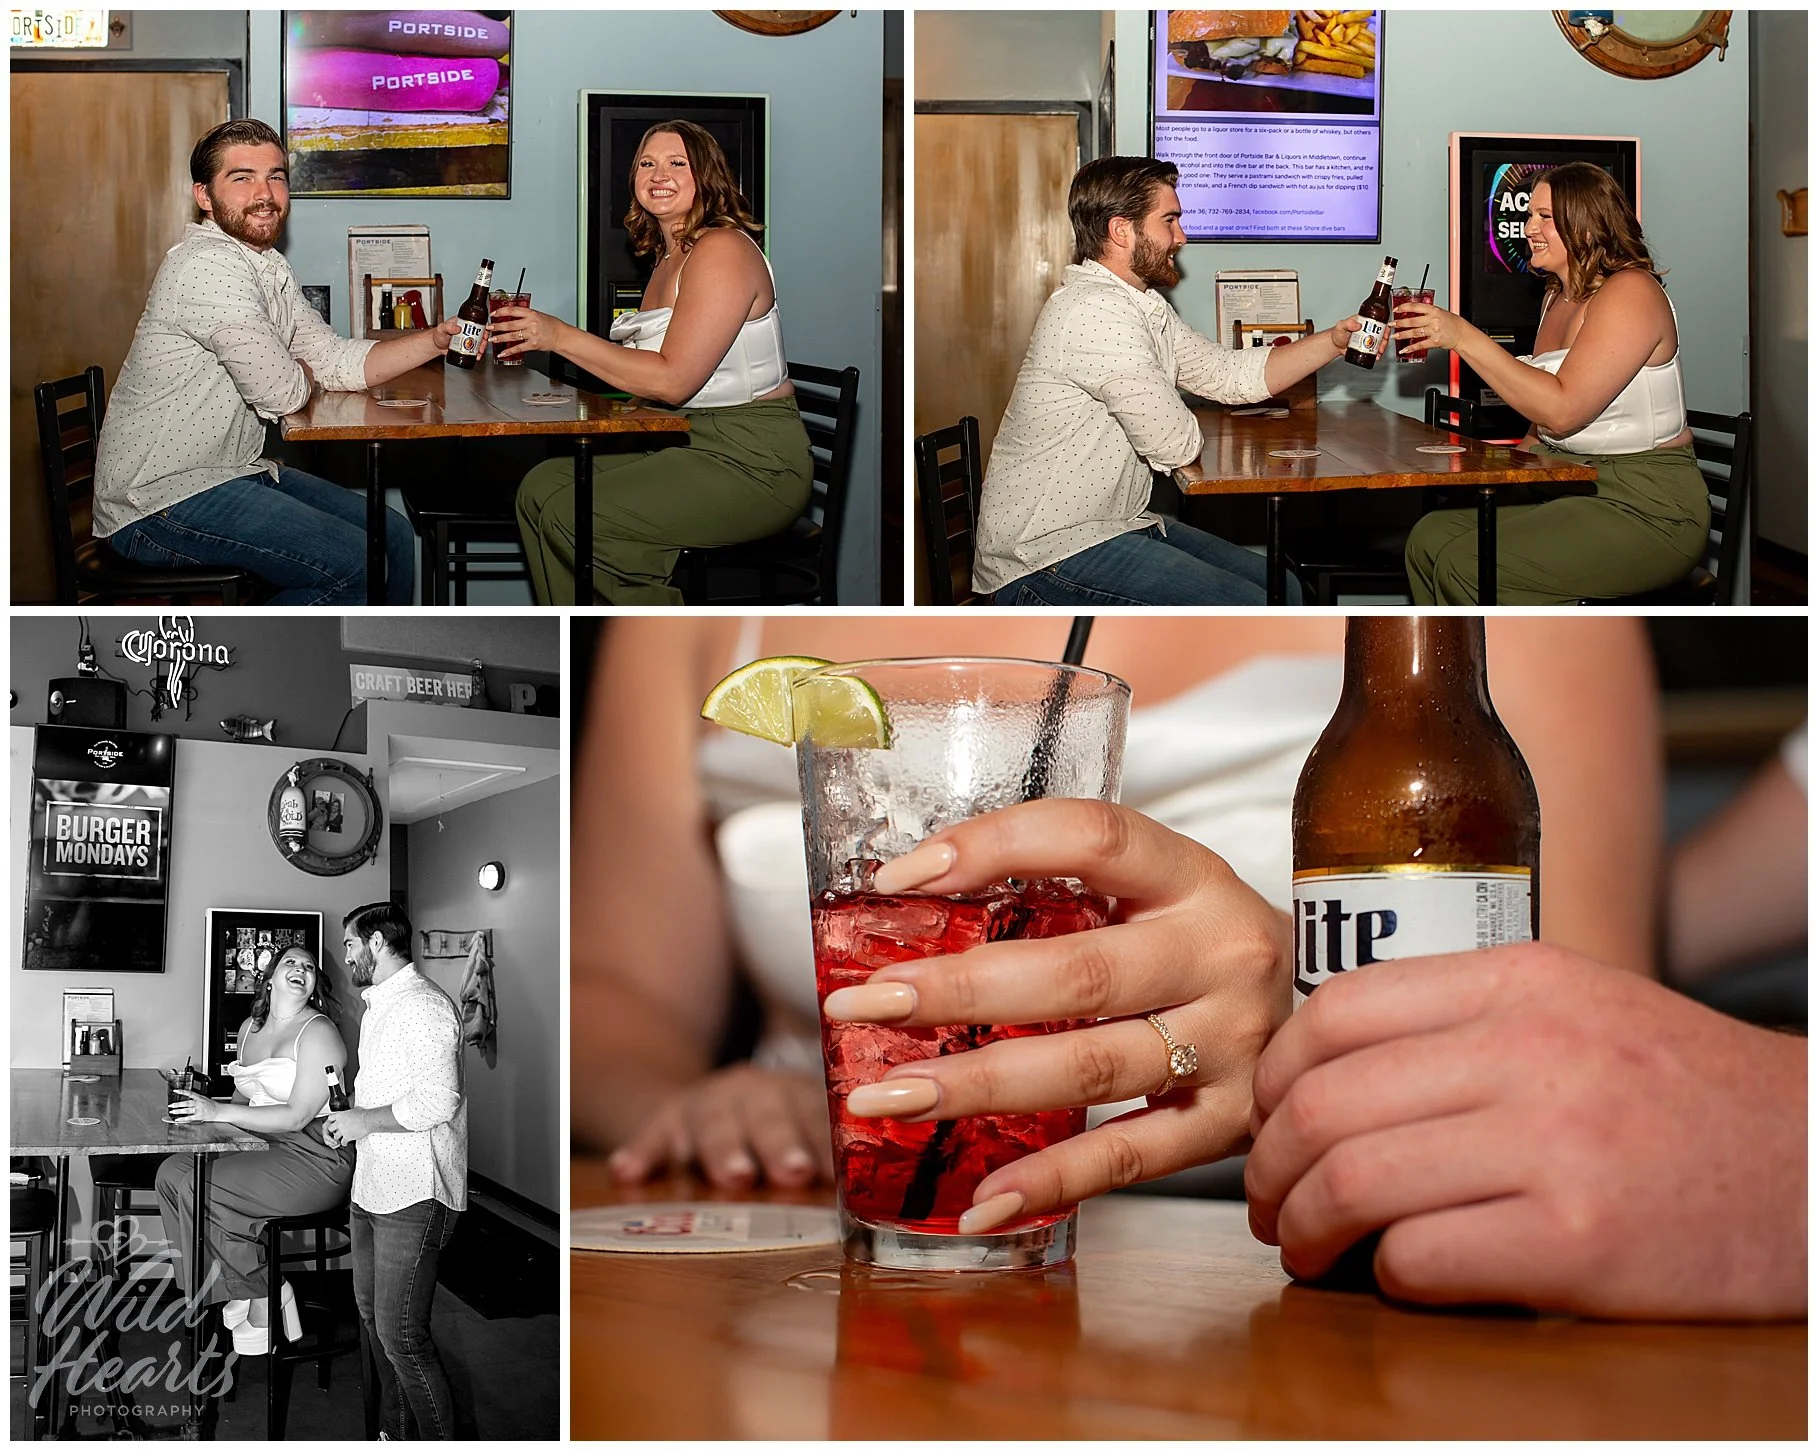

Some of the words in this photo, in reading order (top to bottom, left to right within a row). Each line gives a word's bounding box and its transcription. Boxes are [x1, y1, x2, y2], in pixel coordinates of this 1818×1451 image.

[388, 20, 488, 39] PORTSIDE
[372, 70, 474, 90] PORTSIDE
[1500, 192, 1532, 212] AC
[1498, 222, 1527, 238] SEL
[463, 324, 481, 336] Lite
[1362, 320, 1382, 334] Lite
[122, 630, 229, 666] Corona
[355, 672, 402, 692] CRAFT
[406, 676, 442, 696] BEER
[446, 682, 473, 699] HER
[56, 814, 151, 845] BURGER
[56, 841, 149, 867] MONDAYS
